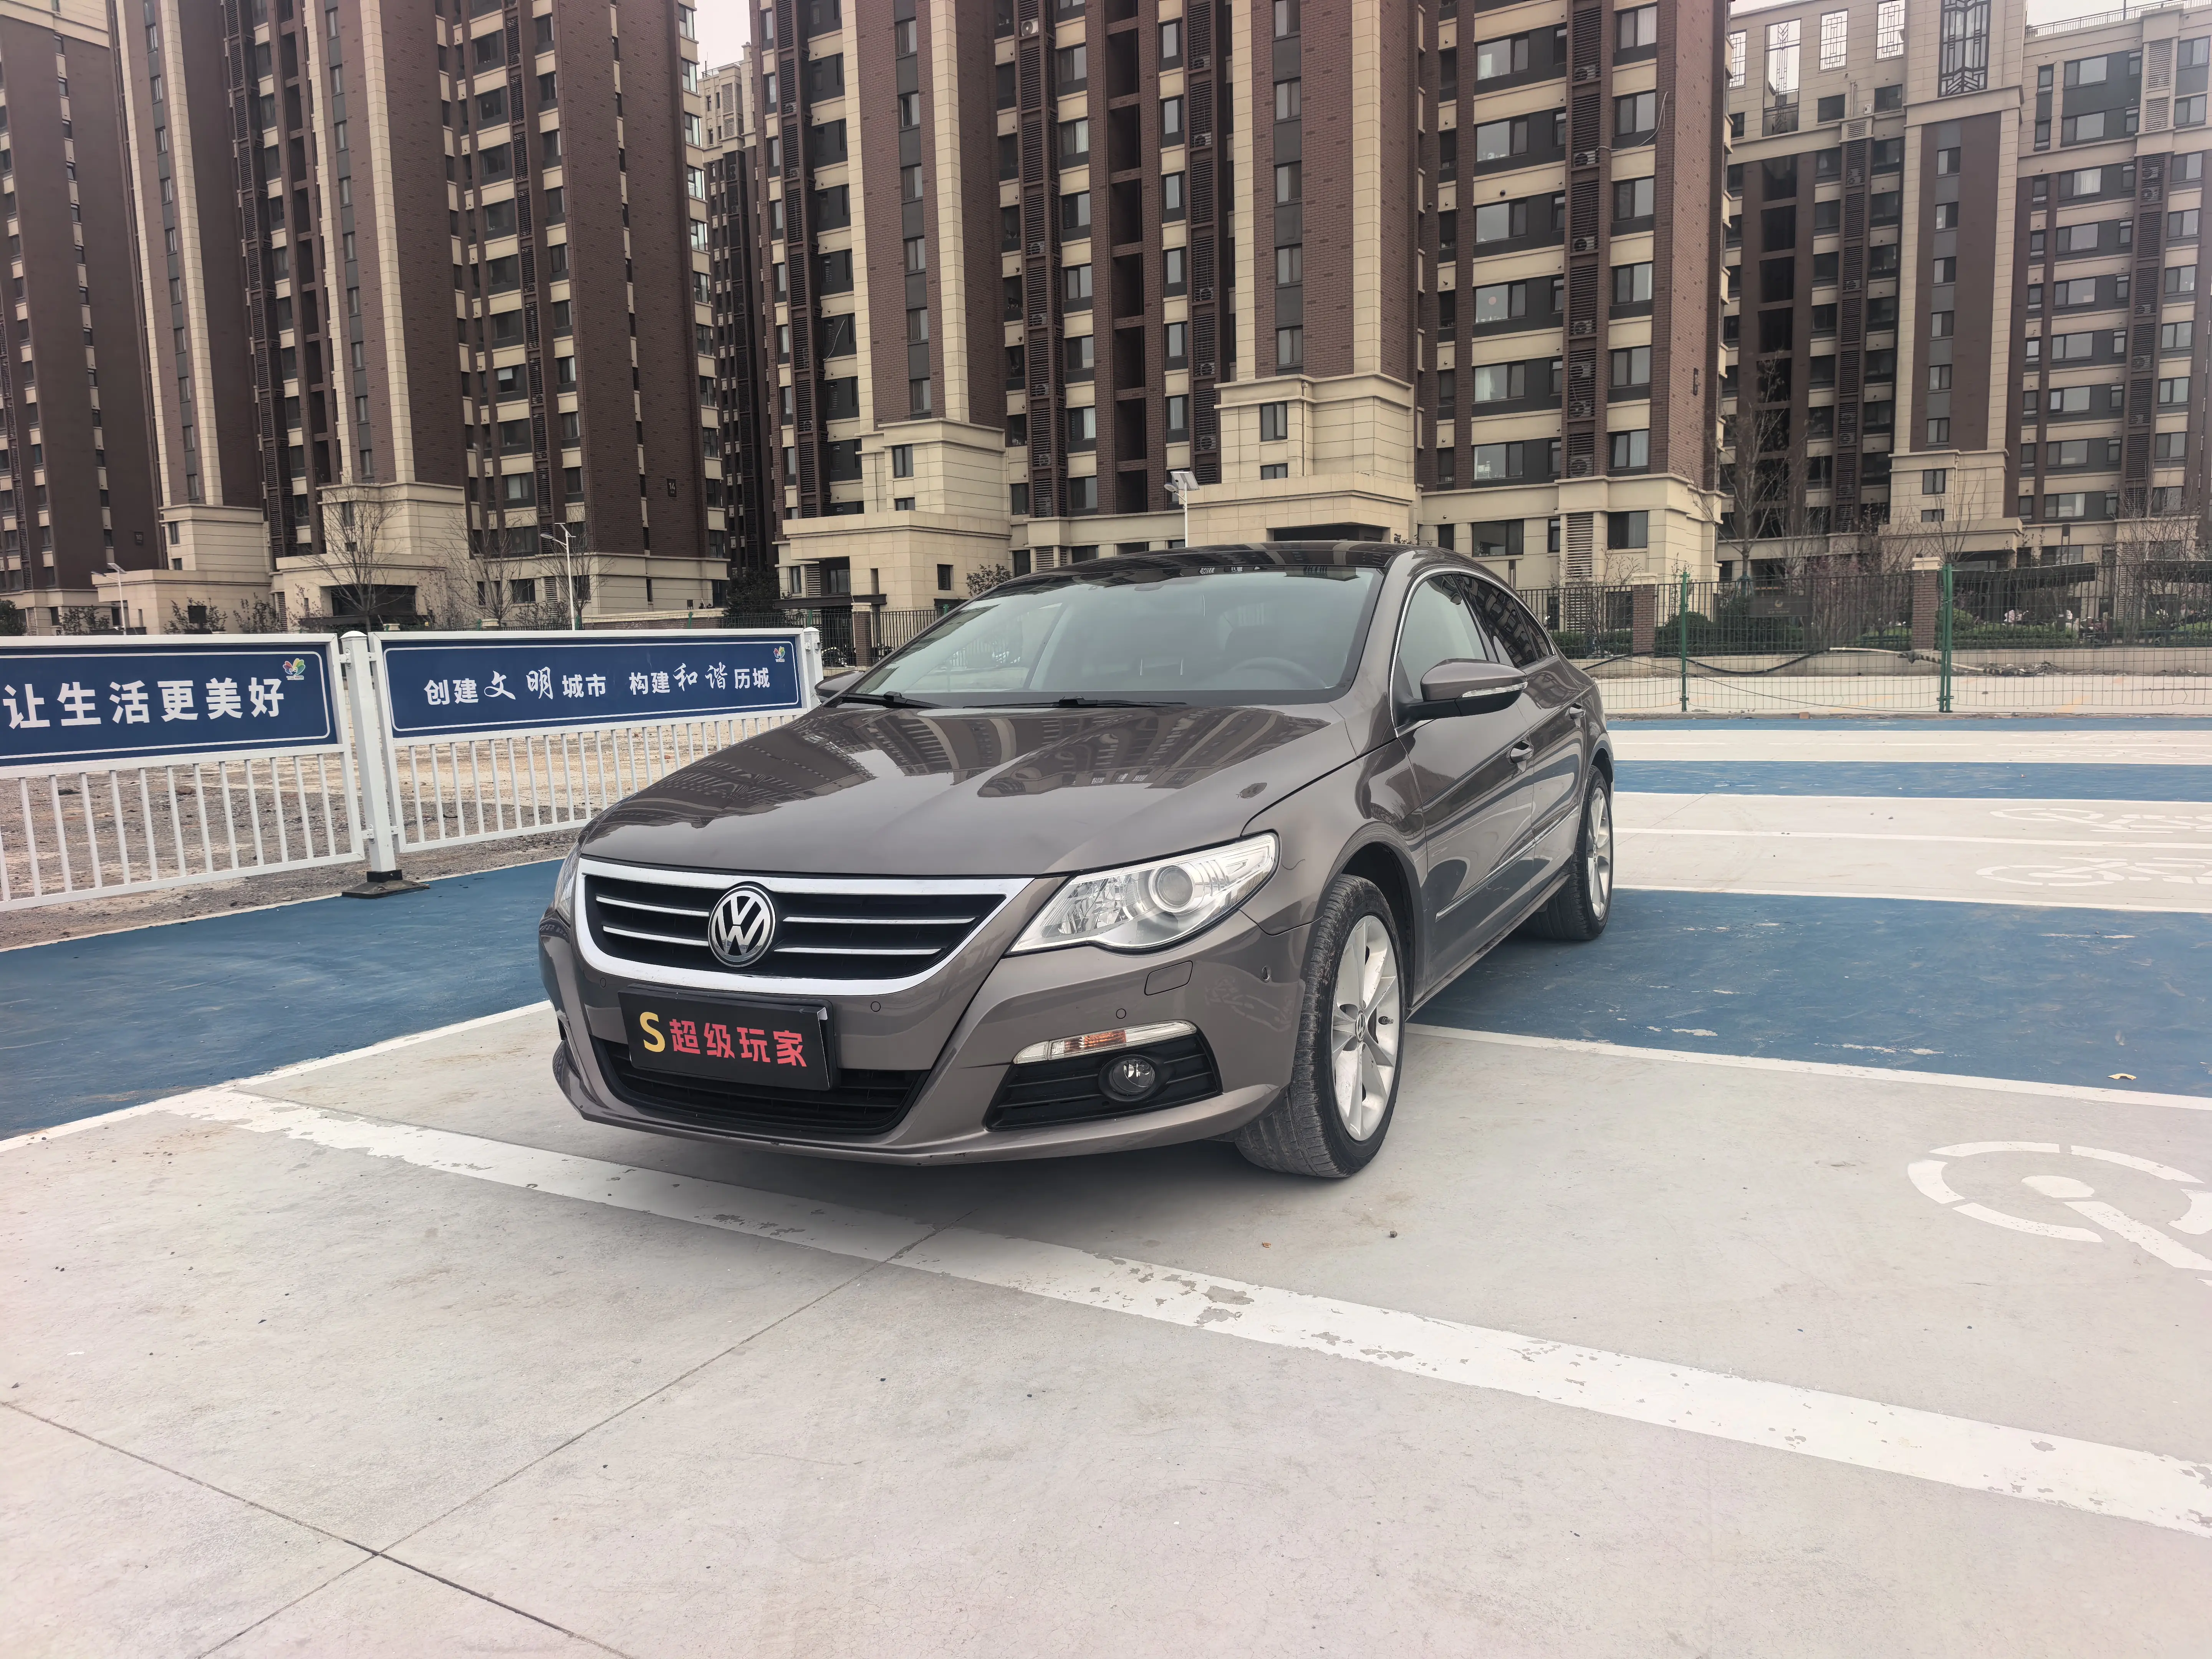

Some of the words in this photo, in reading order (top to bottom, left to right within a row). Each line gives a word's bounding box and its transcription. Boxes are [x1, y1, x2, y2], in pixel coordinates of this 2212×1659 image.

[3, 677, 284, 729] 让生活更美好
[424, 666, 606, 705] 创建文明城市
[629, 662, 770, 695] 构建和谐历城
